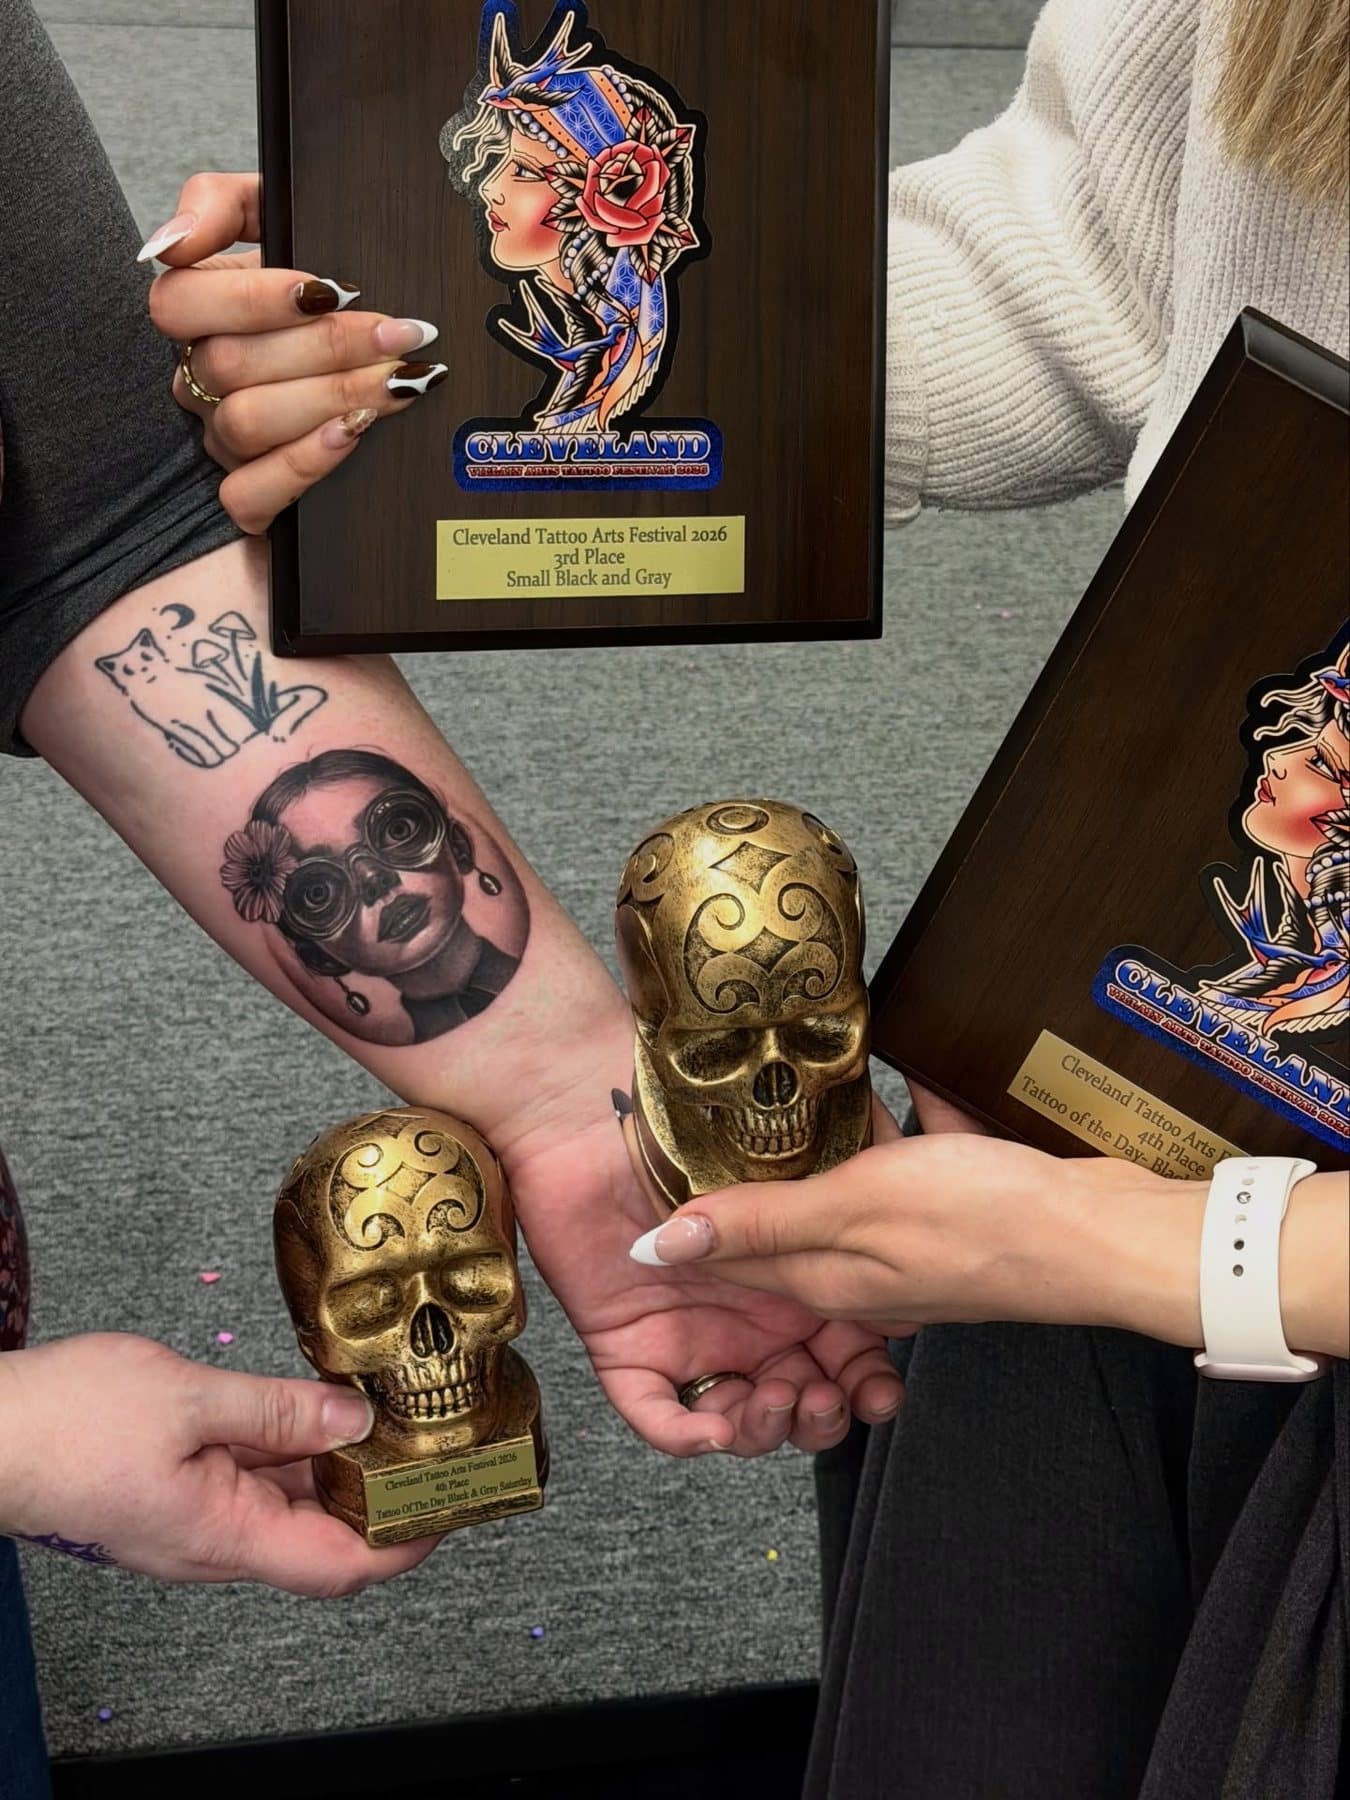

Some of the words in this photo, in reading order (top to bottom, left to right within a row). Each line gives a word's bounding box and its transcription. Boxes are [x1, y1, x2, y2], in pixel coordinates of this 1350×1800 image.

[466, 431, 710, 462] CLEVELAND
[524, 464, 560, 478] ARTS
[560, 464, 612, 477] TATTOO
[611, 464, 676, 477] FESTIVAL
[675, 463, 710, 477] 2026
[453, 527, 531, 546] Cleveland
[535, 527, 587, 545] Tattoo
[592, 526, 625, 544] Arts
[629, 525, 687, 543] Festival
[691, 526, 728, 542] 2026
[553, 548, 580, 569] 3rd
[585, 548, 625, 565] Place
[507, 570, 550, 587] Small
[556, 569, 597, 586] Black
[601, 569, 631, 586] and
[635, 568, 672, 588] Gray
[1107, 983, 1166, 1025] VILLAIN
[1160, 1017, 1201, 1047] ARTS
[1197, 1037, 1253, 1077] TATTOO
[1248, 1068, 1320, 1119] FESTIVAL
[1021, 1075, 1068, 1114] Tattoo
[1069, 1112, 1091, 1126] of
[1087, 1119, 1112, 1143] the
[1113, 1134, 1148, 1163] Day-
[1061, 1054, 1134, 1108] Cleveland
[1135, 1097, 1182, 1137] Tattoo
[1182, 1131, 1216, 1158] Arts
[1137, 1131, 1164, 1151] 4th
[1166, 1142, 1206, 1177] Place
[385, 1473, 423, 1490] Cleveland
[424, 1470, 450, 1482] Tattoo
[467, 1457, 497, 1472] Festival
[448, 1478, 470, 1490] Place
[376, 1507, 401, 1520] Tattoo
[430, 1496, 446, 1508] Day
[448, 1490, 470, 1503] Black
